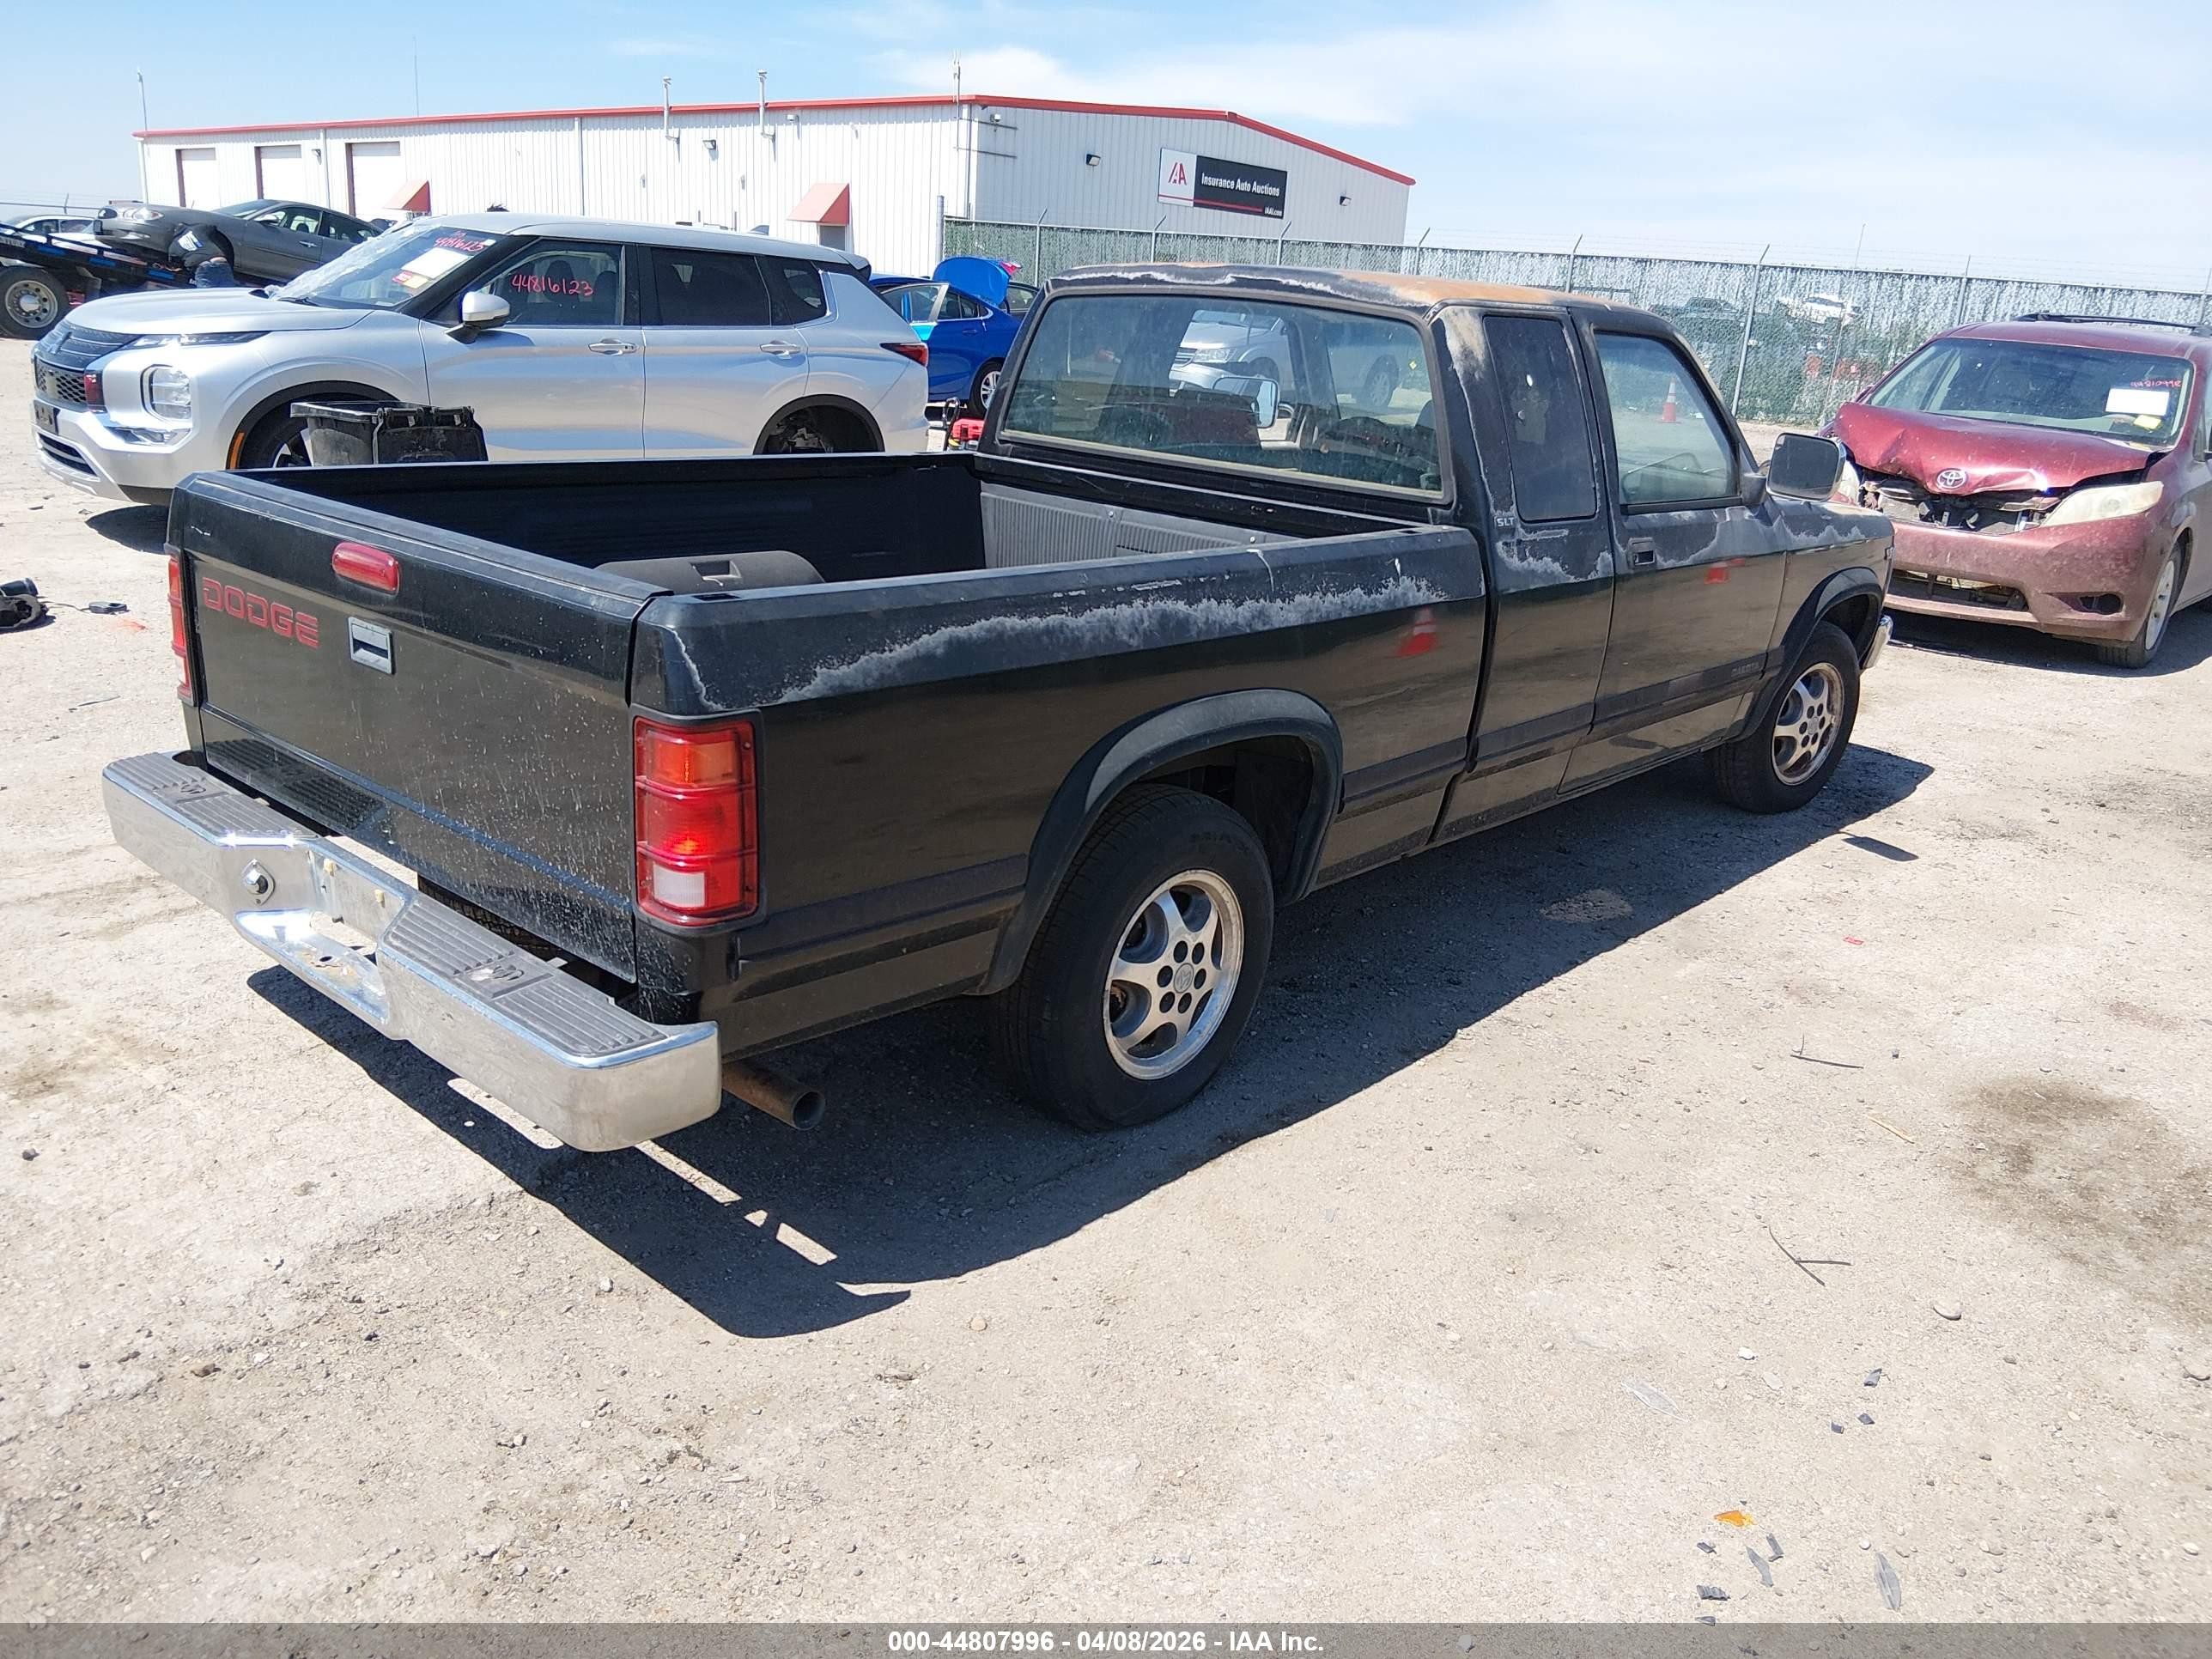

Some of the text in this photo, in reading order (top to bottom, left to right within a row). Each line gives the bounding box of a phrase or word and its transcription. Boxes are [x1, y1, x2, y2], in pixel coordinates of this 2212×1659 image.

[1201, 173, 1279, 197] Insurance Auto Auctions
[511, 274, 594, 296] 44816123
[1497, 517, 1515, 527] SLT
[202, 577, 320, 648] DODGE
